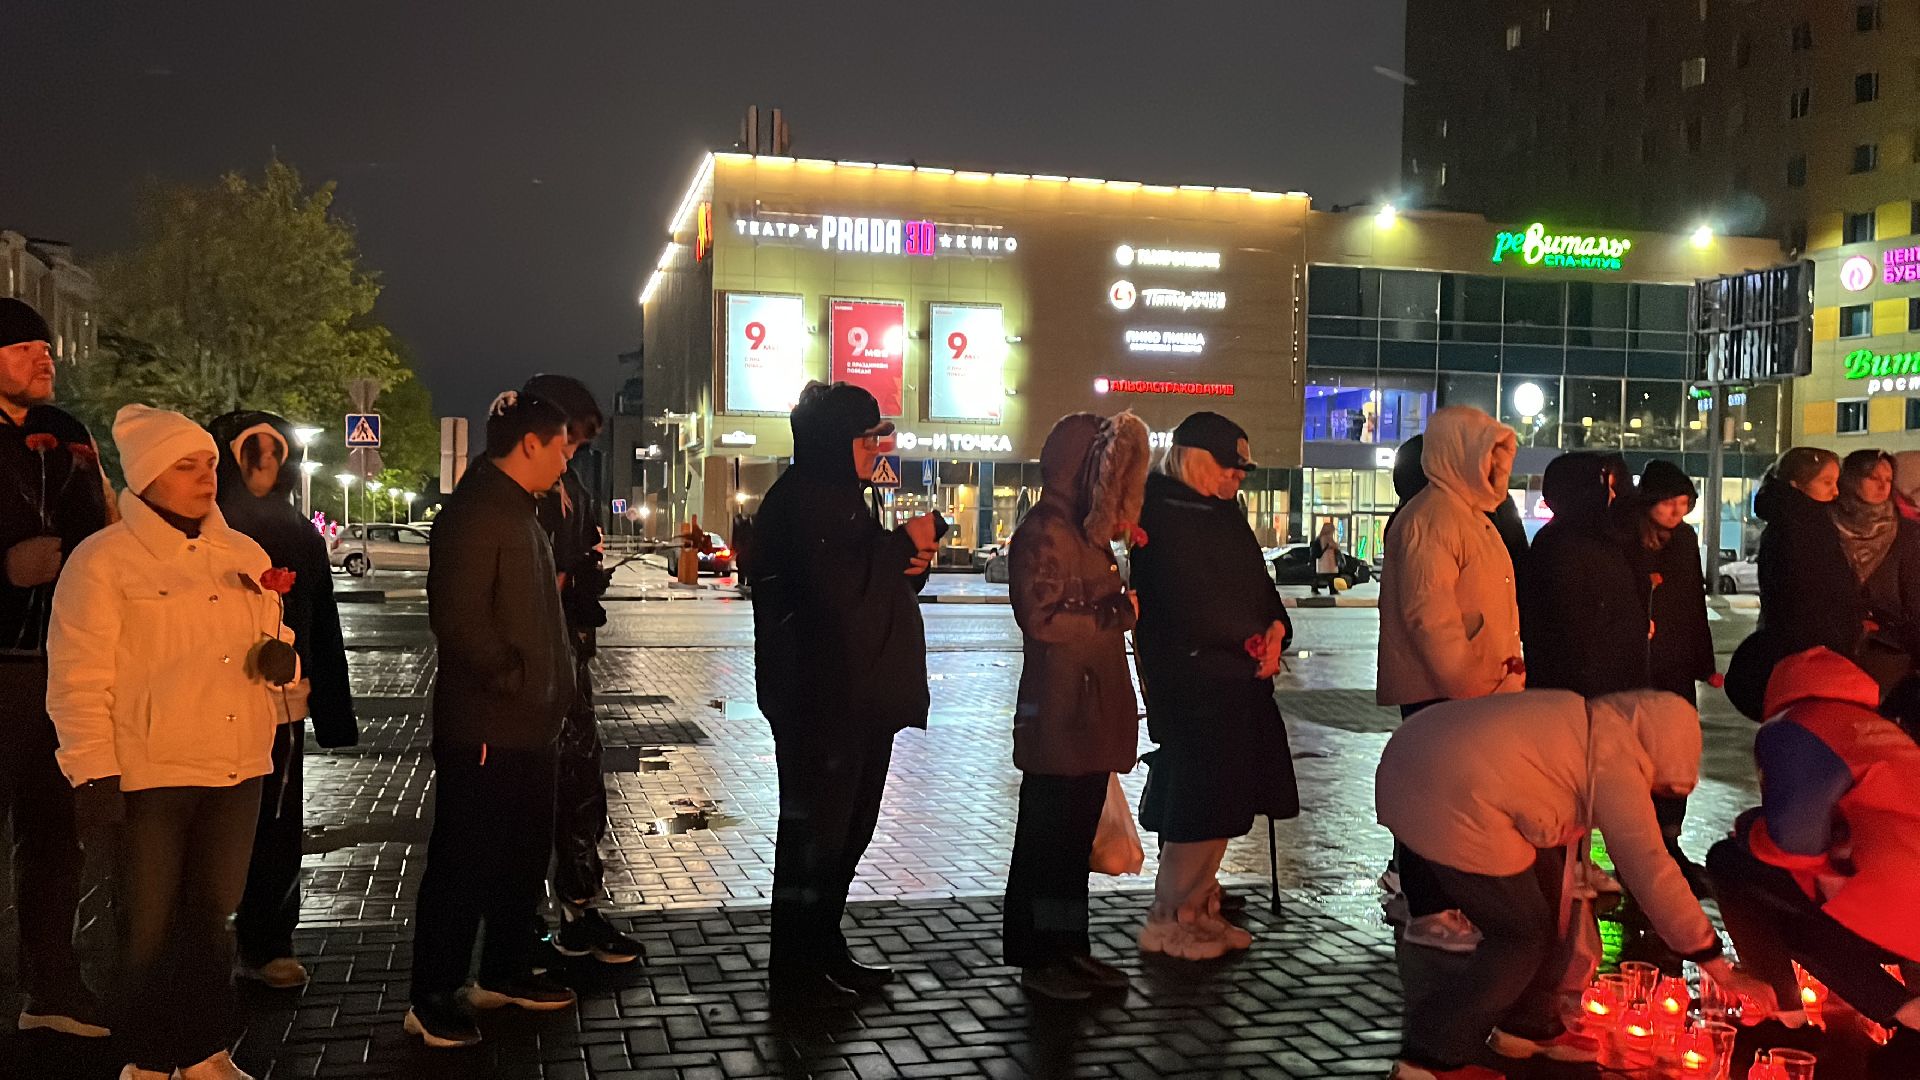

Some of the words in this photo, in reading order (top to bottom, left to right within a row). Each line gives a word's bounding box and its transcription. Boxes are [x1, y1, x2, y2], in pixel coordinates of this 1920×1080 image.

[736, 219, 800, 237] ТЕАТР
[821, 215, 901, 254] PRADA
[905, 221, 935, 256] 3D
[956, 234, 1018, 251] КИНО
[1544, 253, 1622, 270] СПА-КЛУБ
[745, 321, 766, 350] 9
[847, 326, 869, 357] 9
[947, 331, 968, 360] 9
[949, 433, 1013, 452] ТОЧКА
